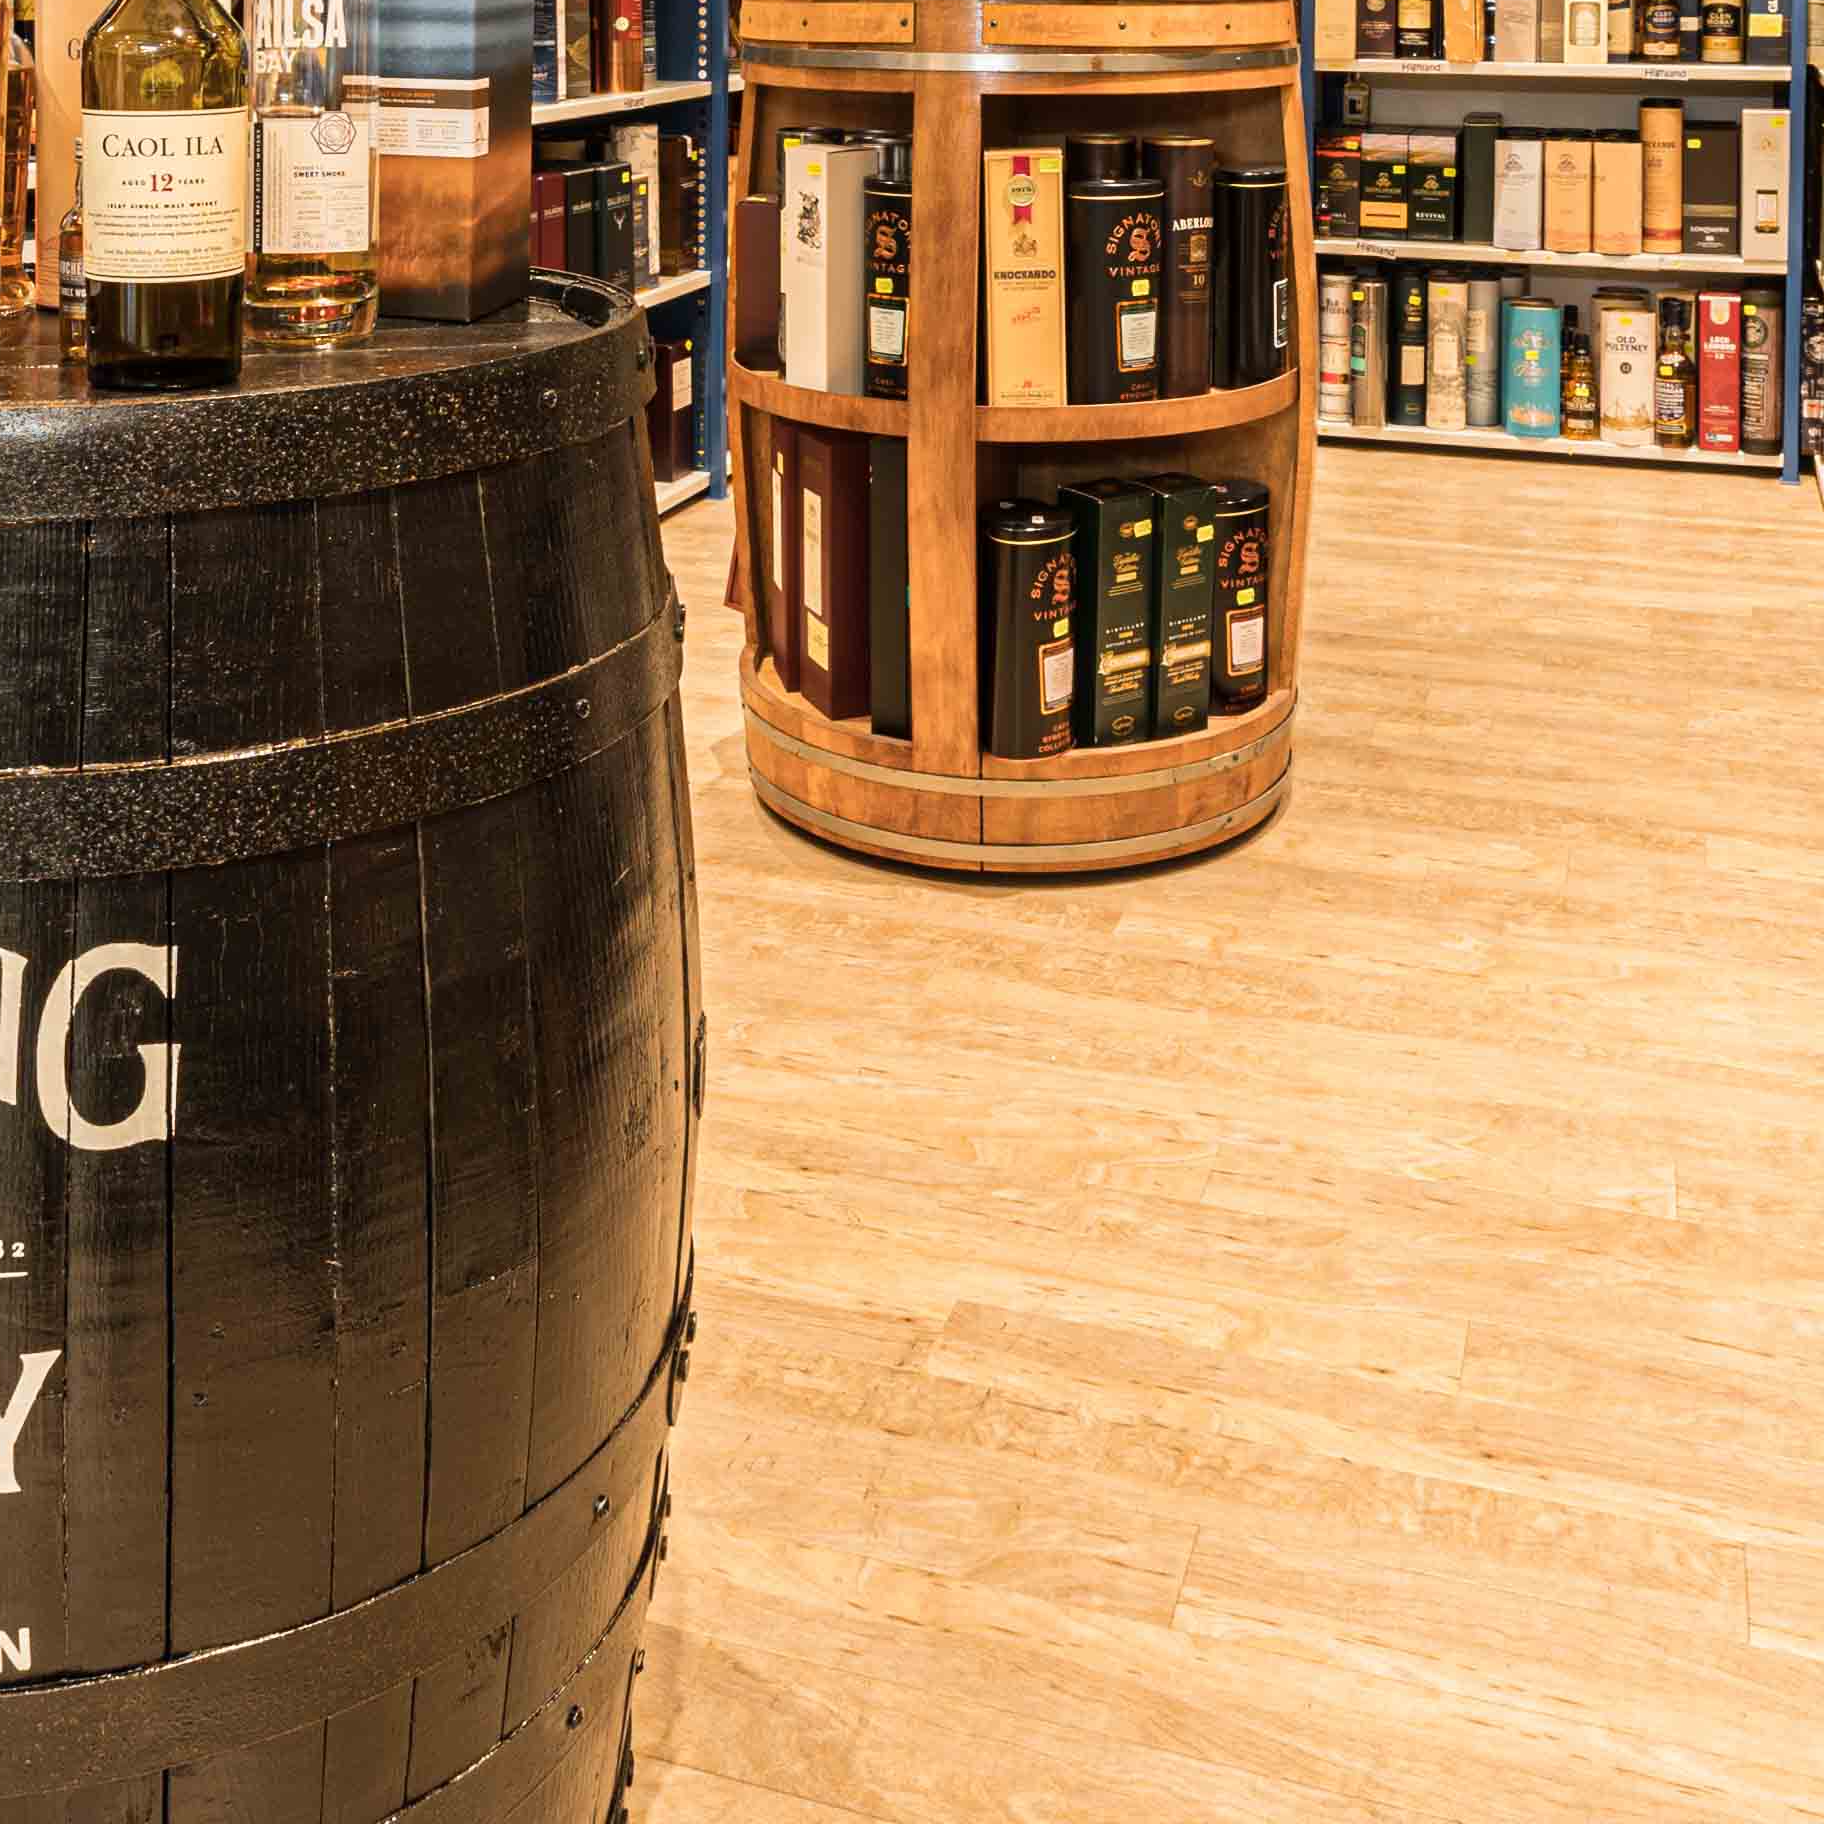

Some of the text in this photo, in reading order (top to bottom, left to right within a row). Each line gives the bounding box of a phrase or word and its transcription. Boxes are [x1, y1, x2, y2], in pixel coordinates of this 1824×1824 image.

[102, 133, 226, 159] CAOL ILA
[149, 173, 174, 193] 12
[292, 170, 320, 179] SWEET
